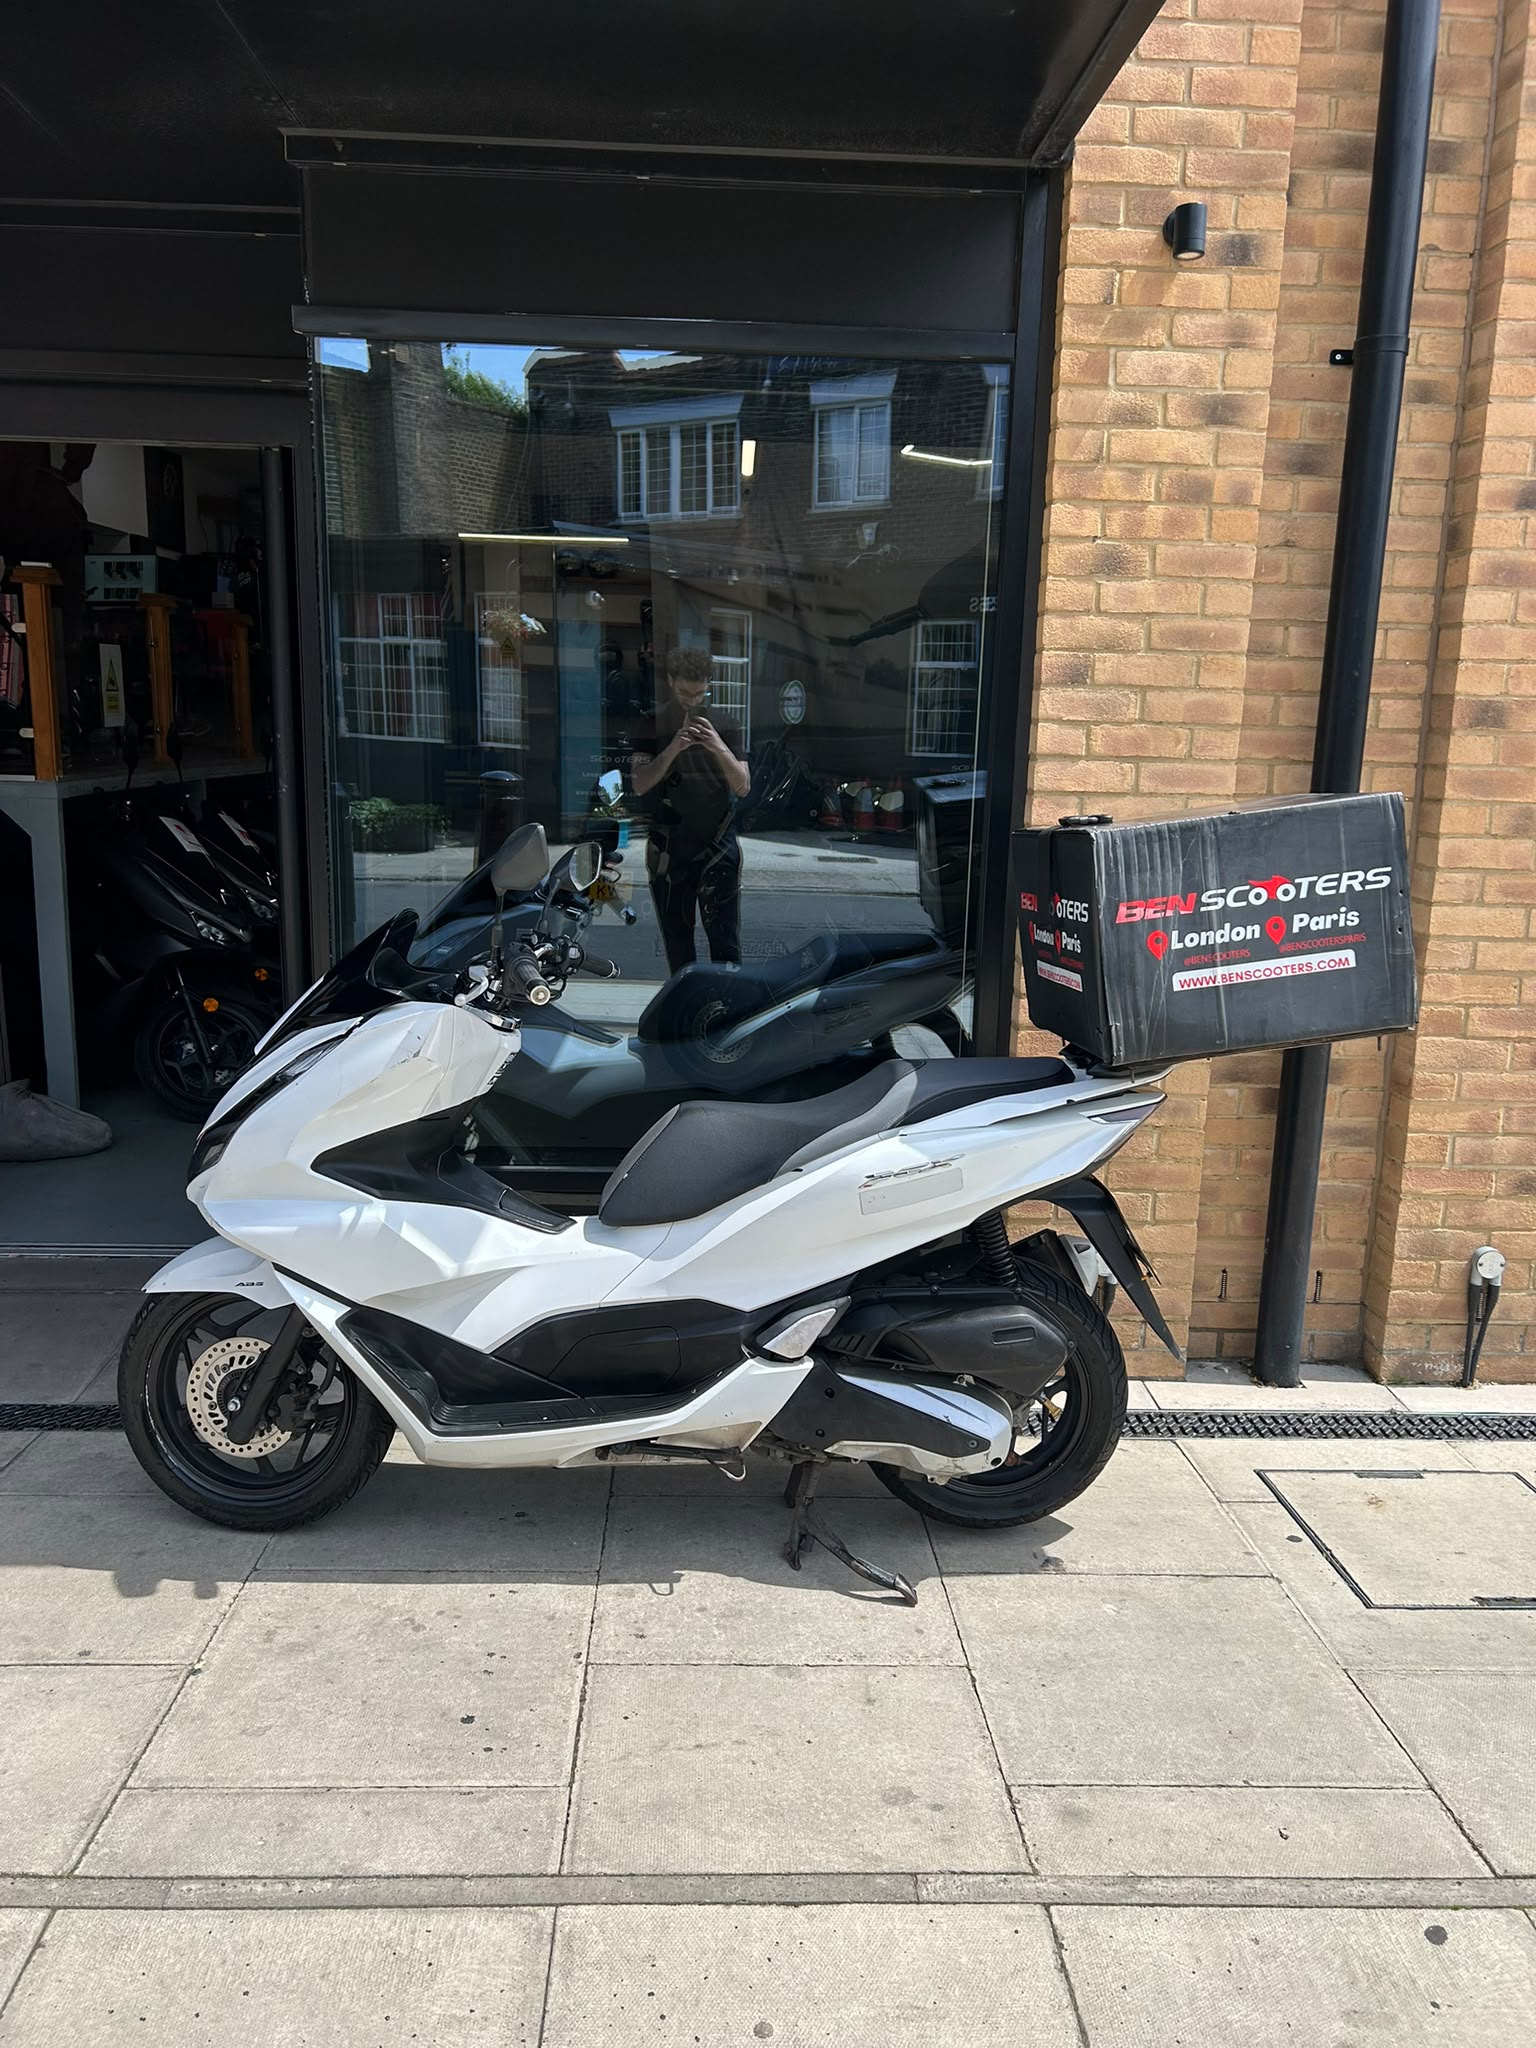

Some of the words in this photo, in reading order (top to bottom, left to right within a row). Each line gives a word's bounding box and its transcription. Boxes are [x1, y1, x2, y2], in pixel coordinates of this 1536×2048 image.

[1020, 891, 1039, 912] BEN
[1115, 892, 1198, 924] BEN
[1062, 931, 1082, 953] Paris
[1171, 922, 1261, 950] London
[1292, 905, 1361, 934] Paris
[1178, 956, 1351, 989] WWW.BENSCOOTERS.COM
